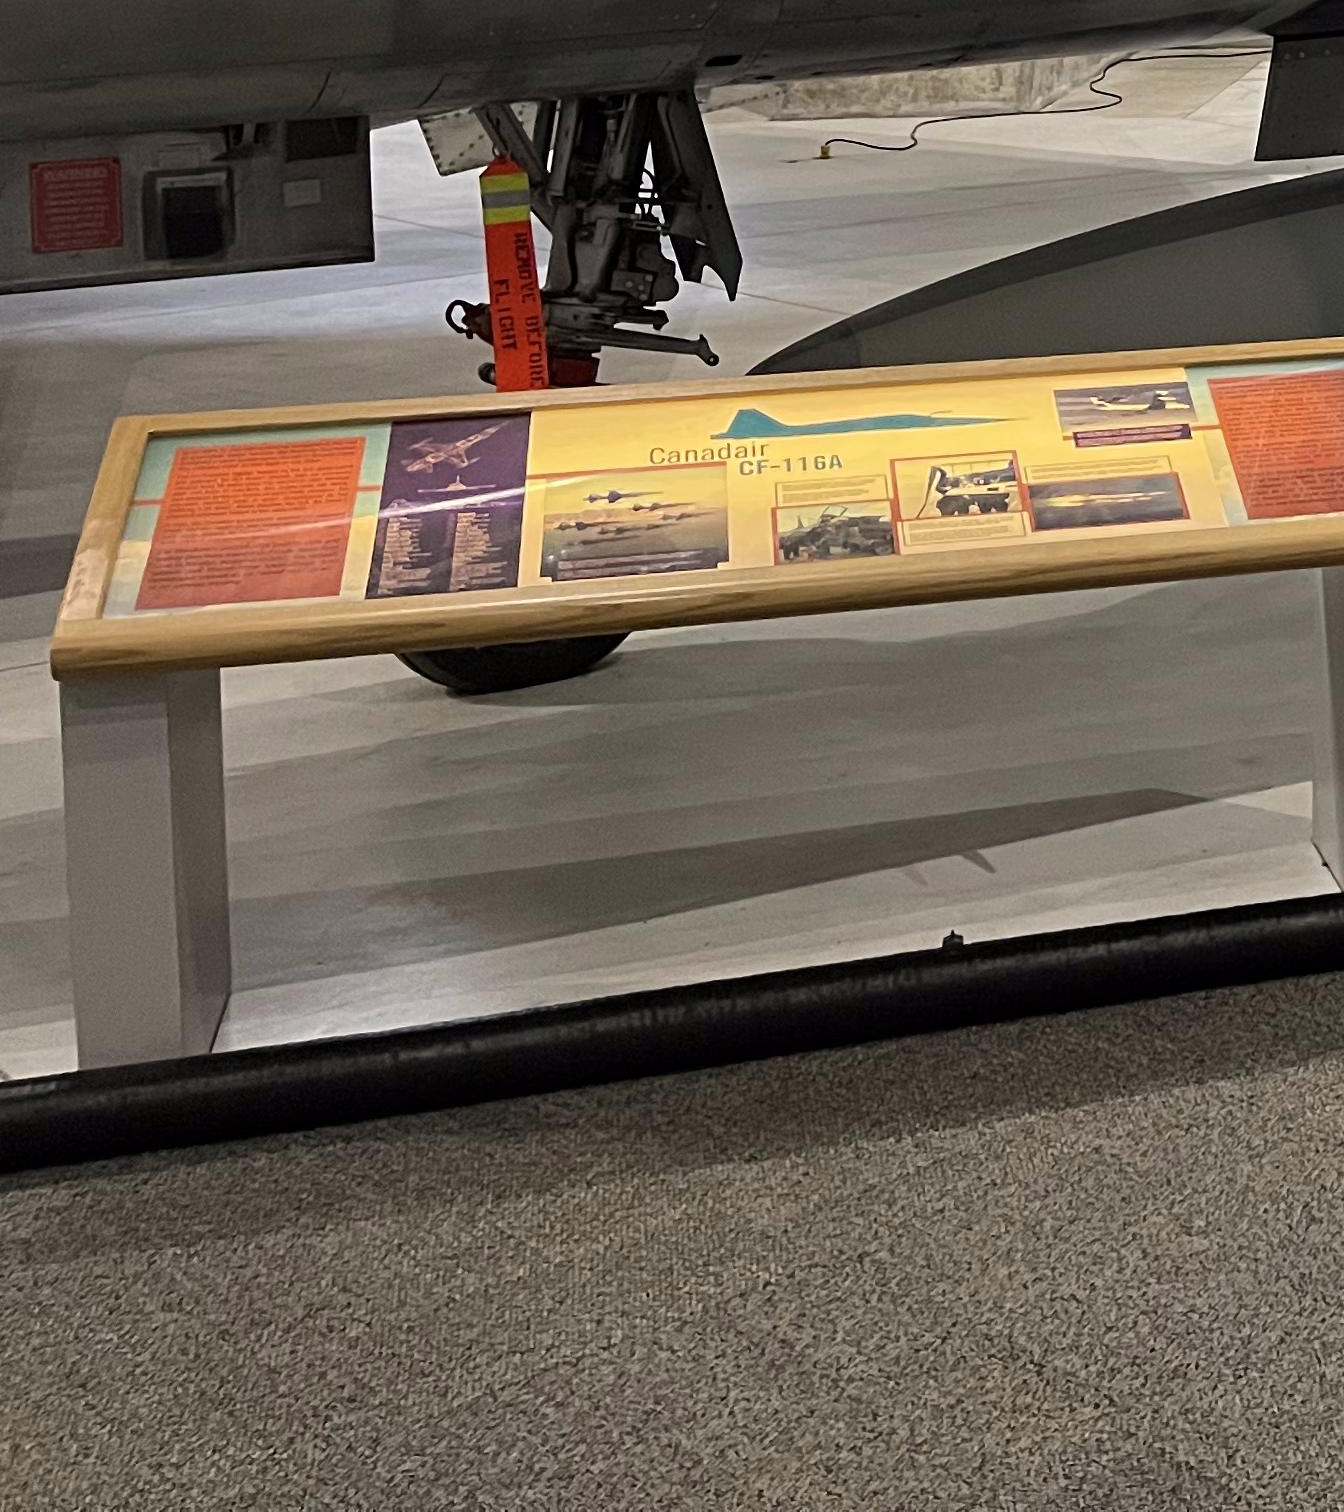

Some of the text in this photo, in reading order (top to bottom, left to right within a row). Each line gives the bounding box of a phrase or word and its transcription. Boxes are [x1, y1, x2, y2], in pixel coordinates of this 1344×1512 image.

[493, 278, 519, 352] FLIGHT
[513, 231, 546, 389] REMOVE BEFORE
[649, 441, 769, 465] Canadair
[738, 454, 844, 477] CF-116A
